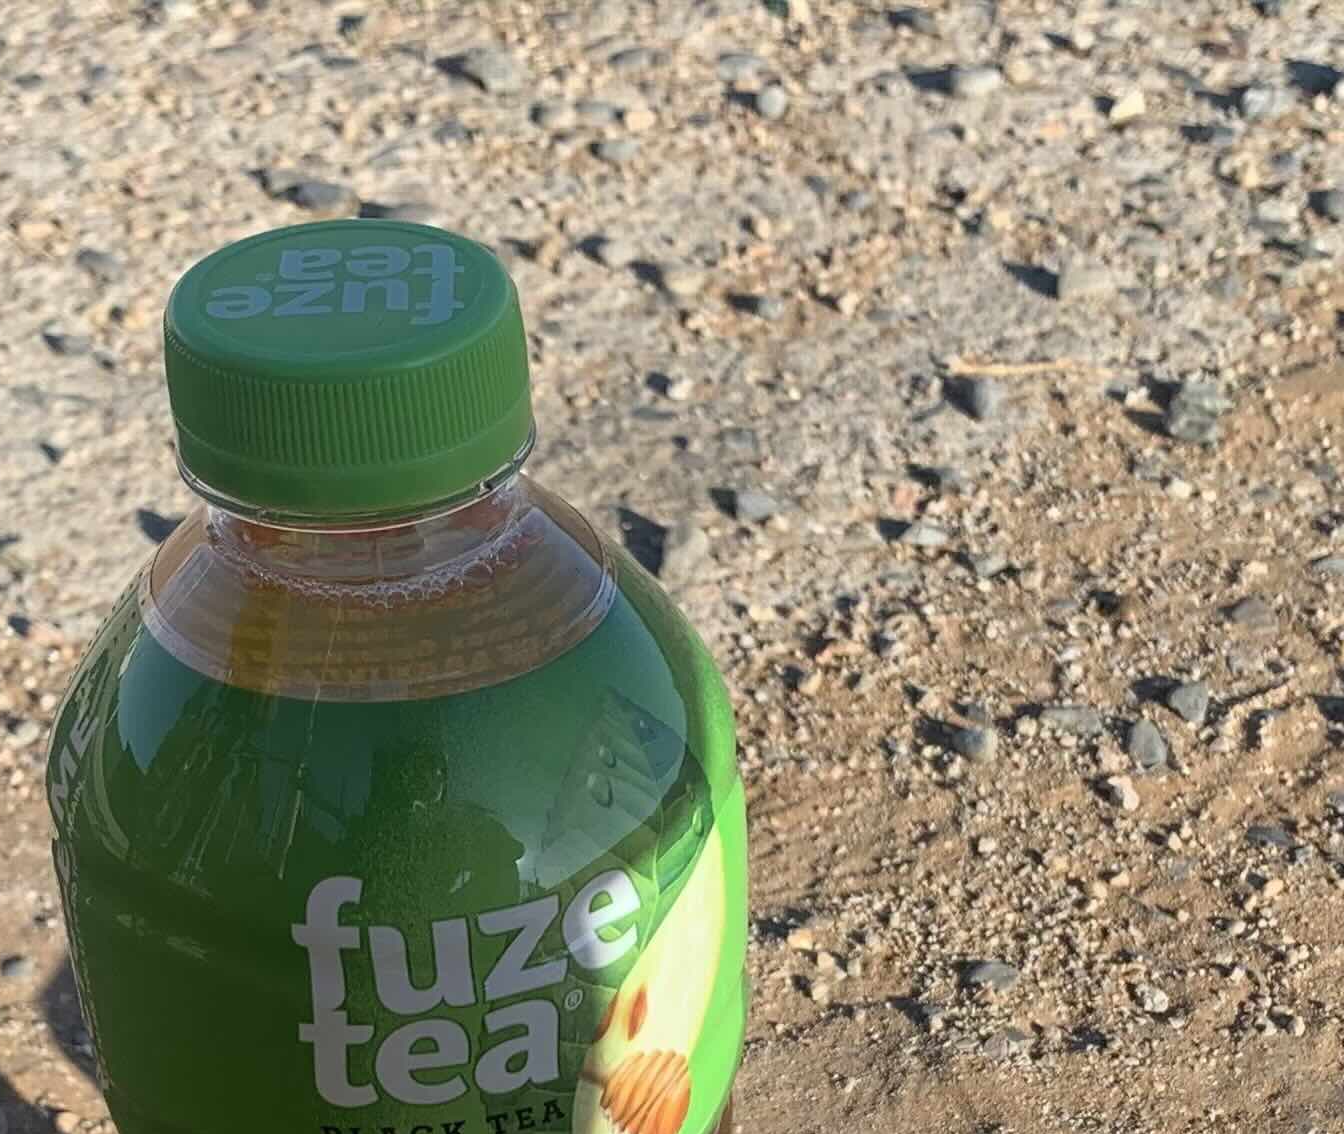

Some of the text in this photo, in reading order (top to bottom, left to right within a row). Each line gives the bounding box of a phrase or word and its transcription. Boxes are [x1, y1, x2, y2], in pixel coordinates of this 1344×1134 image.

[278, 243, 465, 281] tea
[205, 278, 465, 326] fuze
[291, 868, 641, 1015] fuze
[298, 998, 561, 1108] tea
